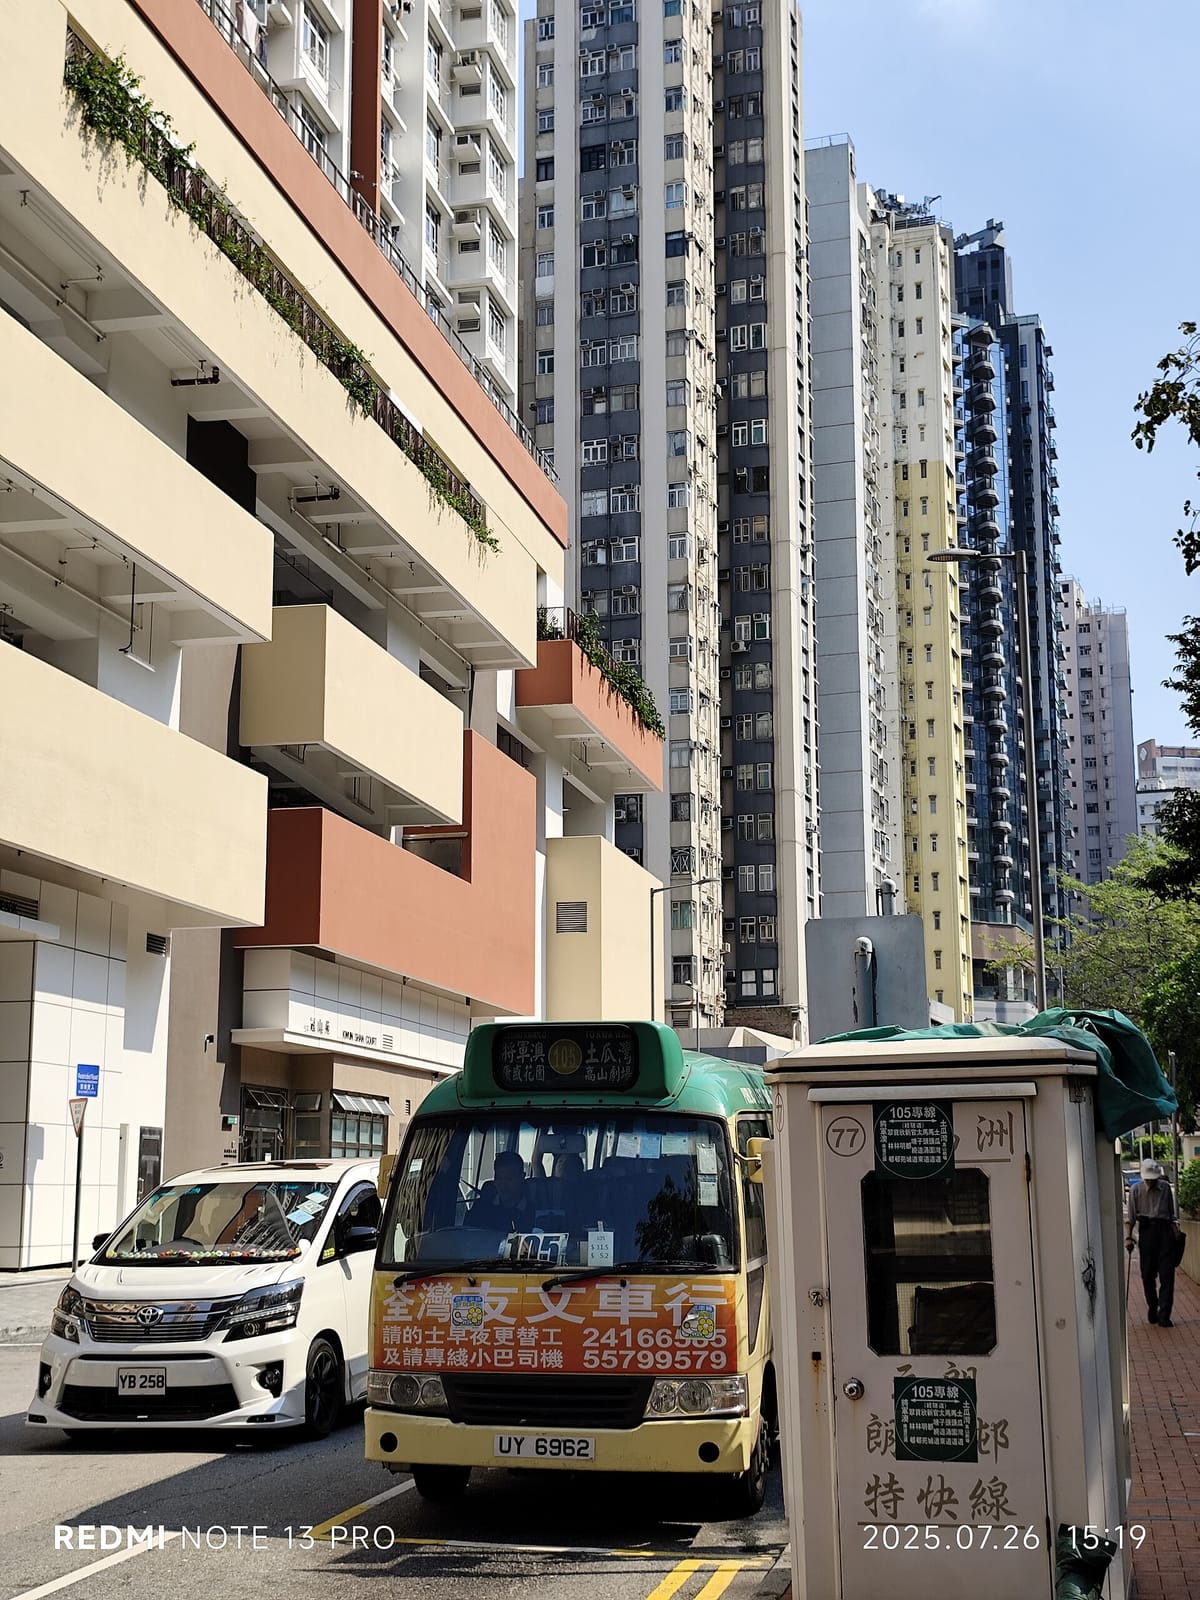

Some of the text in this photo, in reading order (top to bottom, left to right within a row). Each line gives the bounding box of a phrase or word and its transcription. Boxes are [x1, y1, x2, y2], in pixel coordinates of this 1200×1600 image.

[503, 1041, 546, 1064] 將軍澳
[554, 1045, 577, 1068] 105
[585, 1041, 632, 1065] 土瓜灣
[585, 1065, 632, 1082] 高山劇場
[890, 1106, 936, 1119] 105專線
[832, 1128, 859, 1148] 77
[507, 1235, 560, 1262] 105
[382, 1326, 563, 1347] 請的士早夜更替工
[382, 1347, 728, 1370] 及請專綫小巴司機 55799579
[119, 1374, 165, 1389] YB 258
[911, 1385, 959, 1398] 105專線
[499, 1436, 590, 1457] UY 6962
[866, 1413, 1010, 1464] 朗邨
[864, 1472, 1018, 1521] 特快線
